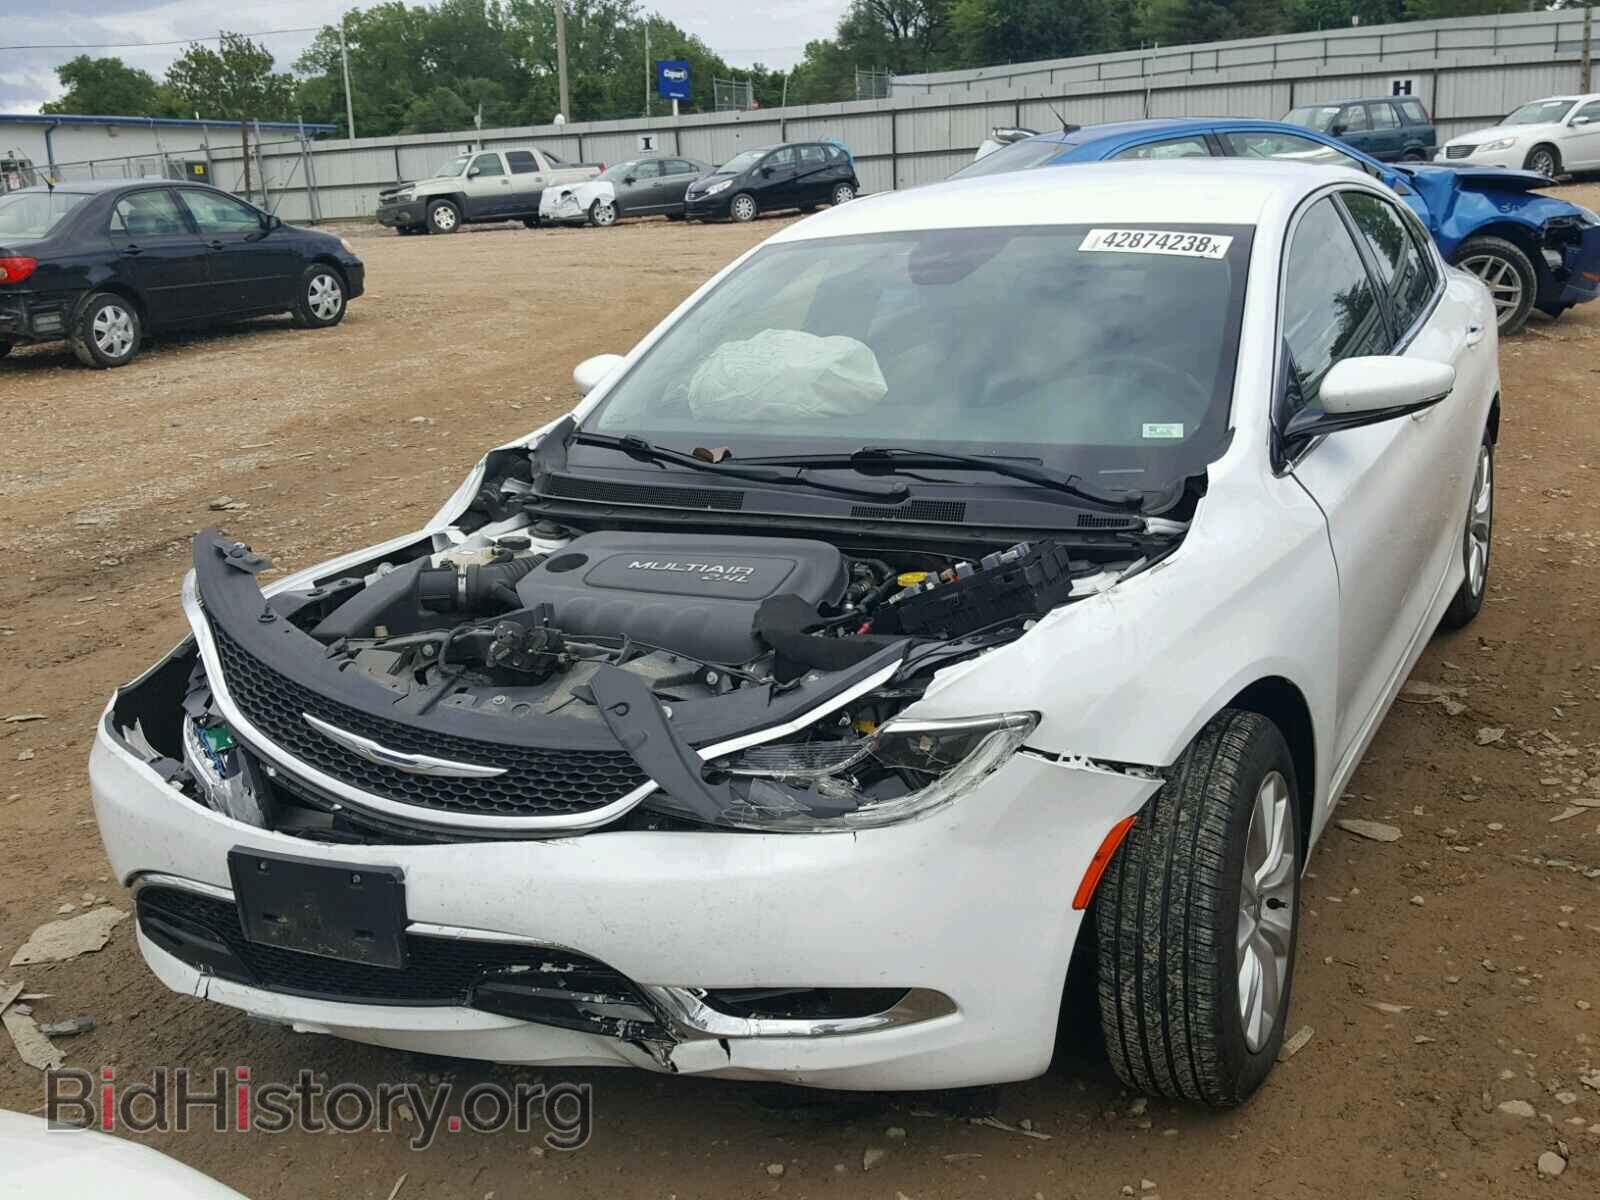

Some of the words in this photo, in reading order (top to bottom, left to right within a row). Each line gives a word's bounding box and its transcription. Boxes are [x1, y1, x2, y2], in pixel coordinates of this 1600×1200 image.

[1393, 80, 1412, 96] H
[641, 136, 653, 151] I
[627, 560, 756, 576] MULTIAIR
[700, 574, 751, 584] 2.4L
